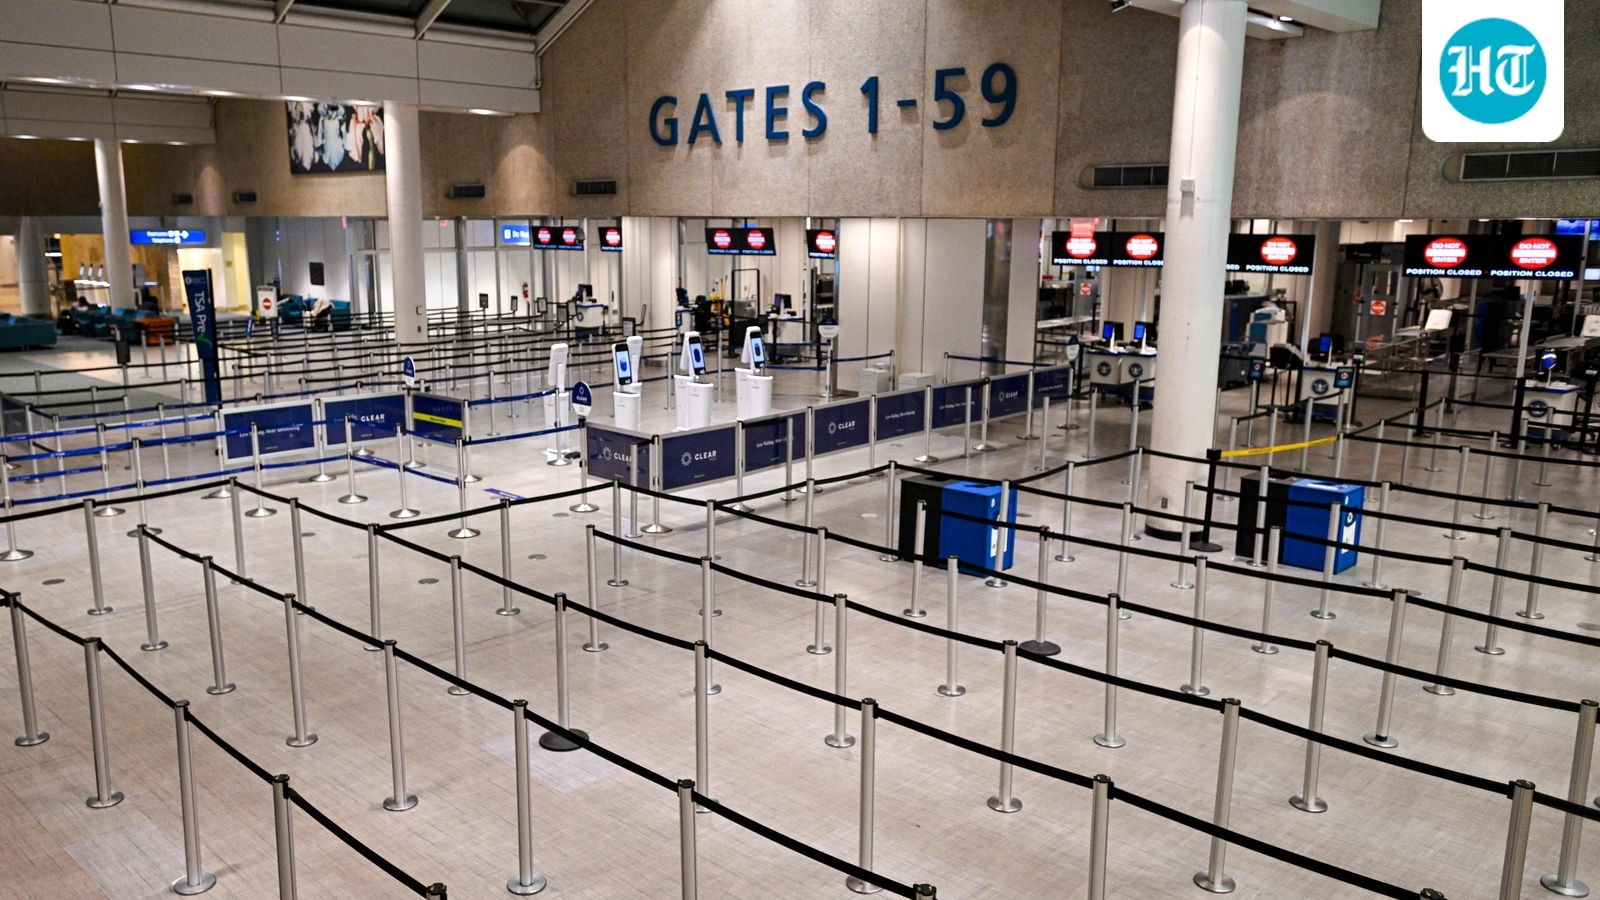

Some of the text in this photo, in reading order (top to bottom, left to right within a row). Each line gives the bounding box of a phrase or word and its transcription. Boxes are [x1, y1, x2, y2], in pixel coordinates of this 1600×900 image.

[649, 62, 1018, 146] GATES 1-59
[1246, 264, 1279, 272] POSITION
[1535, 270, 1574, 278] CLOSED
[194, 291, 206, 313] TSA
[360, 414, 385, 422] CLEAR
[838, 420, 855, 430] CLEAR
[614, 452, 632, 462] CLEA
[694, 450, 717, 461] CLEAR
